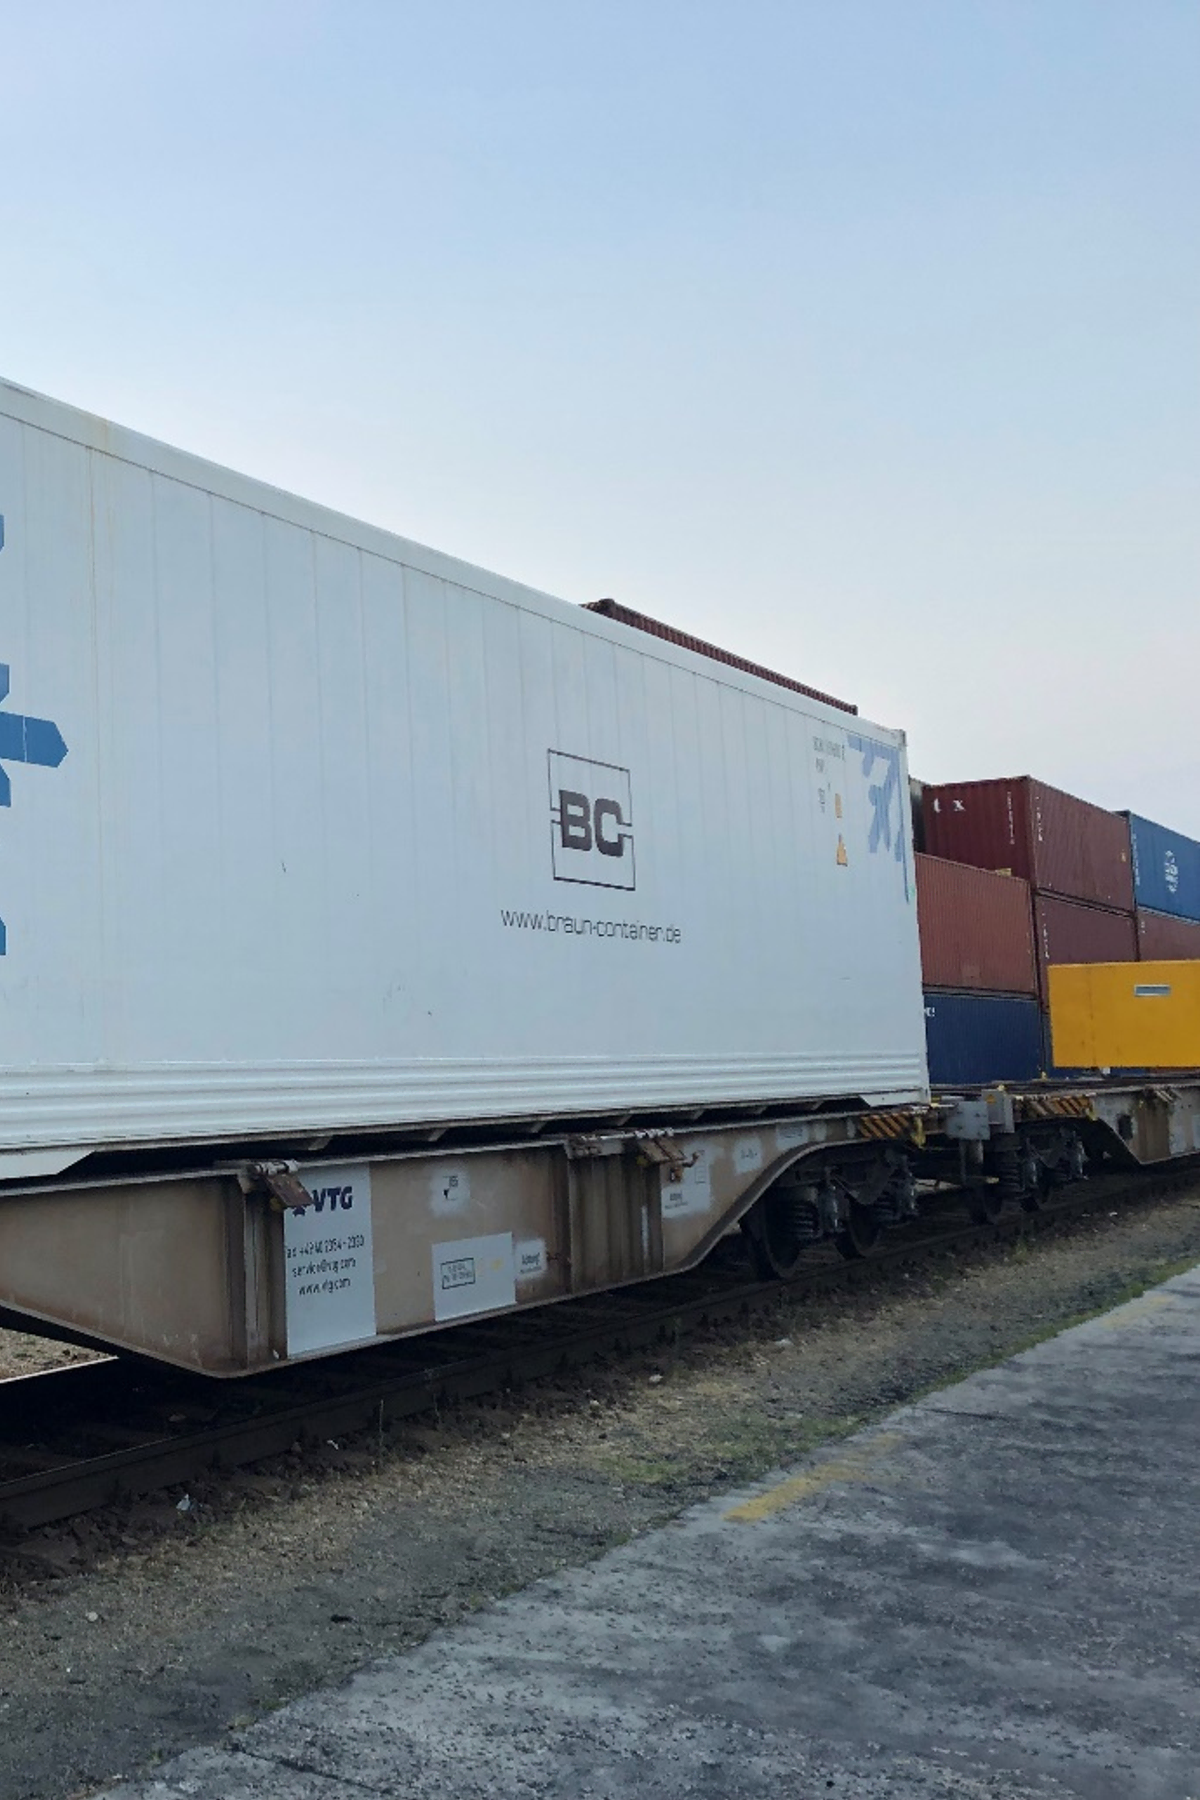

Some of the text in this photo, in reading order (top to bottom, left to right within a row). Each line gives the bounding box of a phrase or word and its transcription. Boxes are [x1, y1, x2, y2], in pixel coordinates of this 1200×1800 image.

[559, 789, 624, 857] BC
[500, 908, 682, 944] www.braun-container.de
[312, 1186, 353, 1212] VTG
